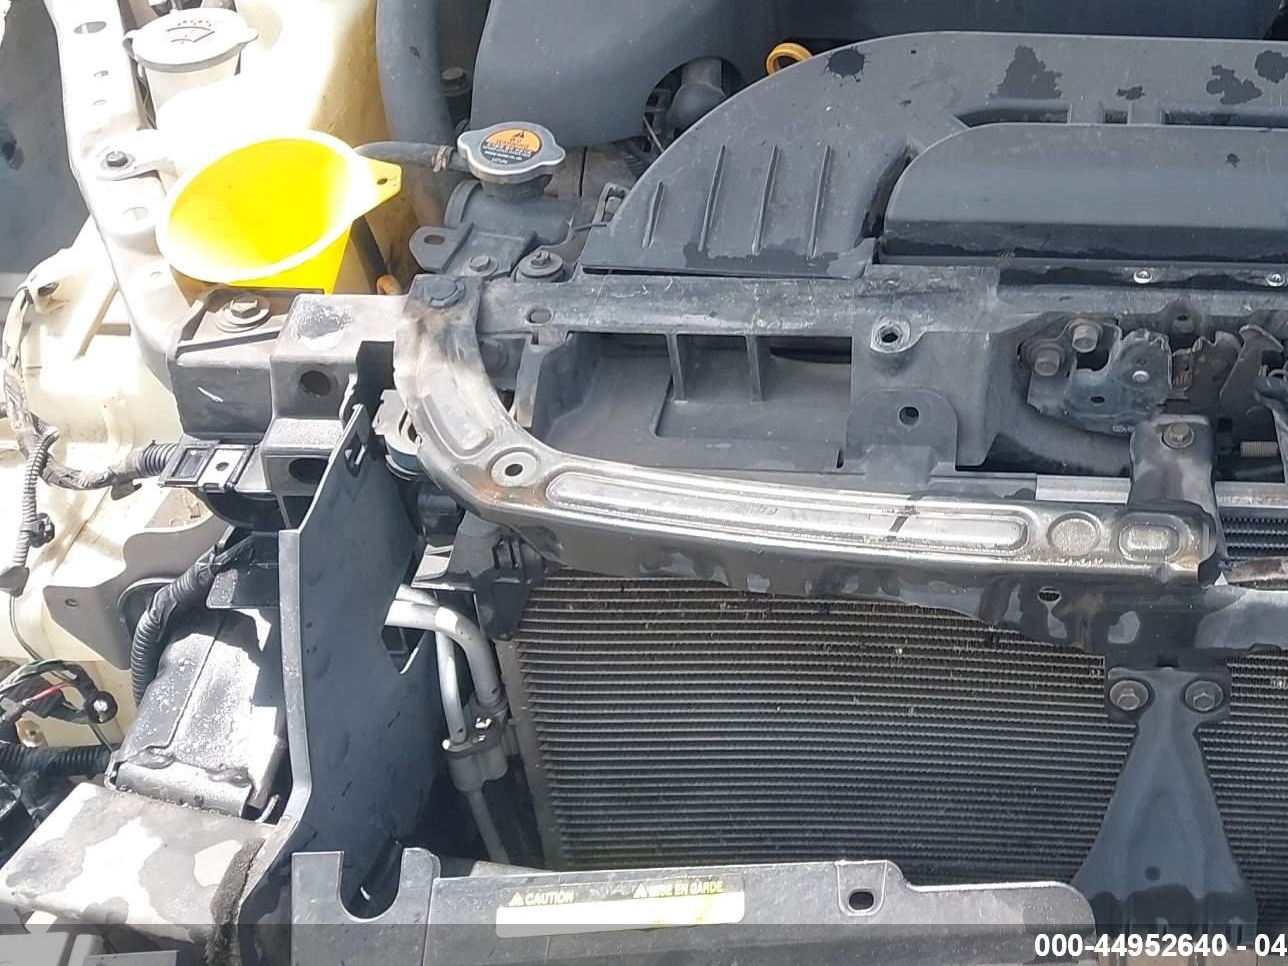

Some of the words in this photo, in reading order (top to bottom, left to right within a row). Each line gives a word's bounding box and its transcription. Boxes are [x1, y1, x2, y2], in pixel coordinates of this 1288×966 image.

[674, 881, 690, 896] EN
[689, 880, 724, 895] GARDE
[524, 890, 574, 906] CAUTION
